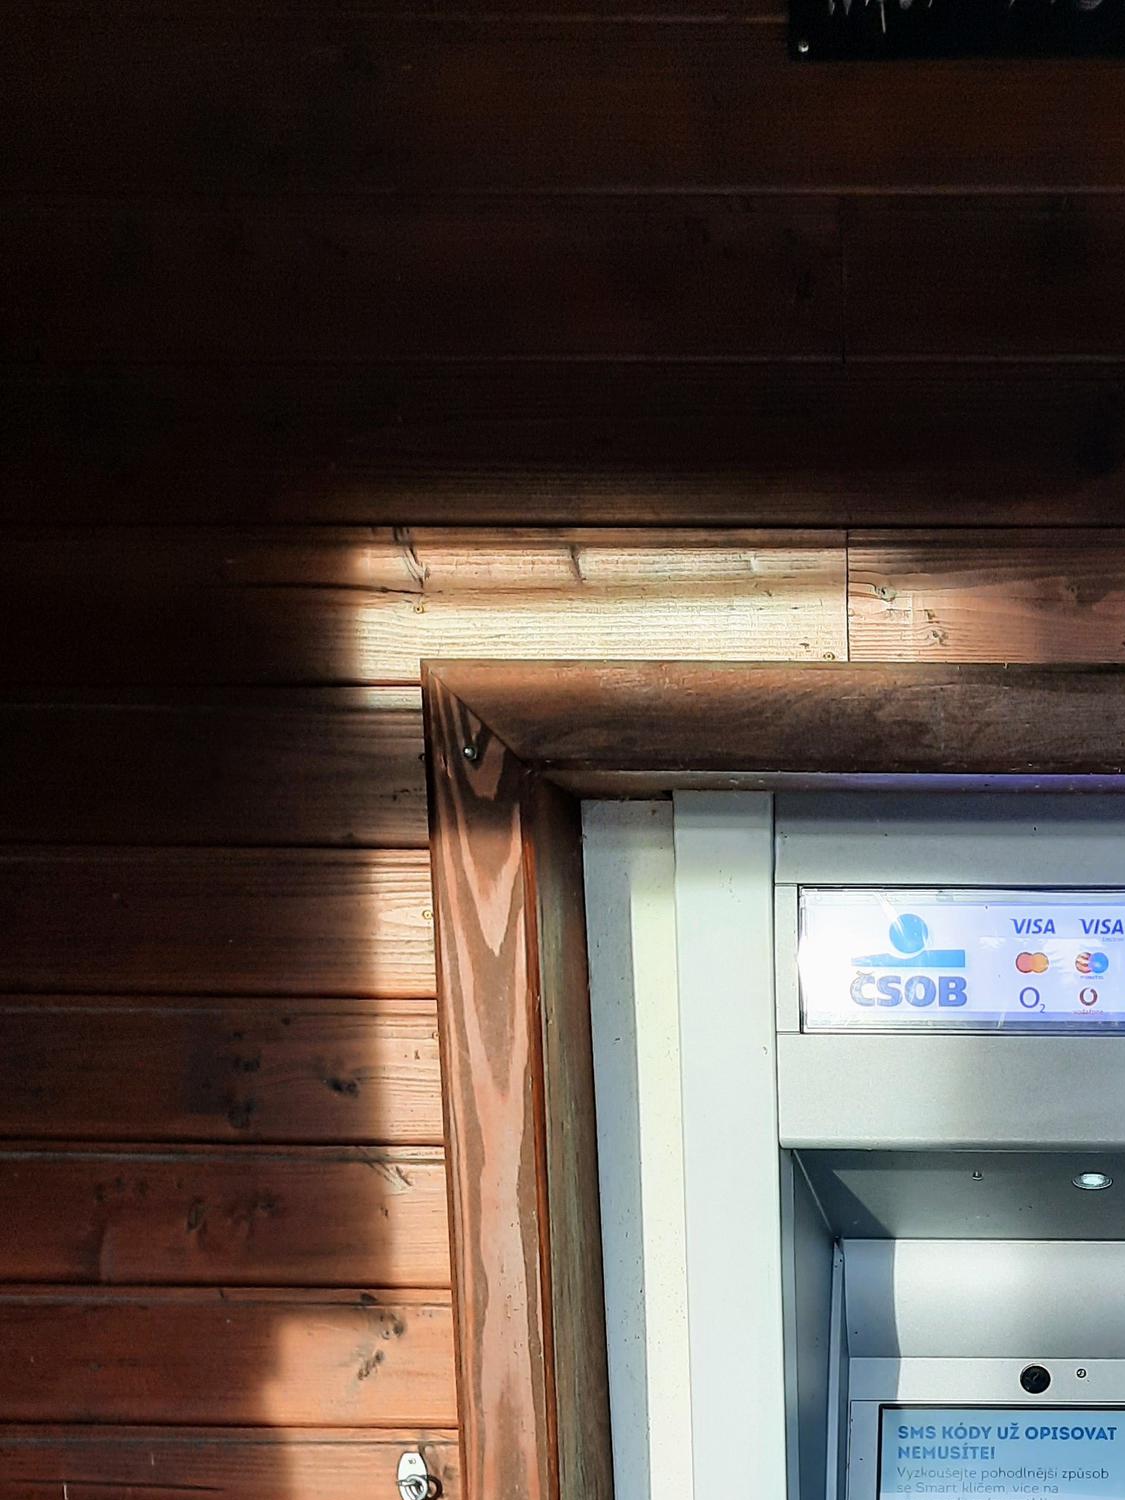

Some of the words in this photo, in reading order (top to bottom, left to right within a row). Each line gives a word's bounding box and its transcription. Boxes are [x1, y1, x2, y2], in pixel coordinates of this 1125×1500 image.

[1010, 918, 1056, 935] VISA
[1079, 918, 1124, 935] VISA
[850, 970, 968, 1008] ČSOB
[897, 1425, 936, 1440] SMS
[942, 1422, 992, 1440] KÓDY
[997, 1422, 1020, 1440] UŽ
[1024, 1426, 1117, 1441] OPISOVAT
[897, 1443, 996, 1460] NEMUSÍTE!
[897, 1466, 977, 1481] Vyzkoušejte
[981, 1466, 1058, 1481] pohodlnější
[1062, 1466, 1110, 1481] způsob
[896, 1484, 912, 1494] se
[915, 1481, 958, 1494] Smart
[1043, 1484, 1059, 1494] na
